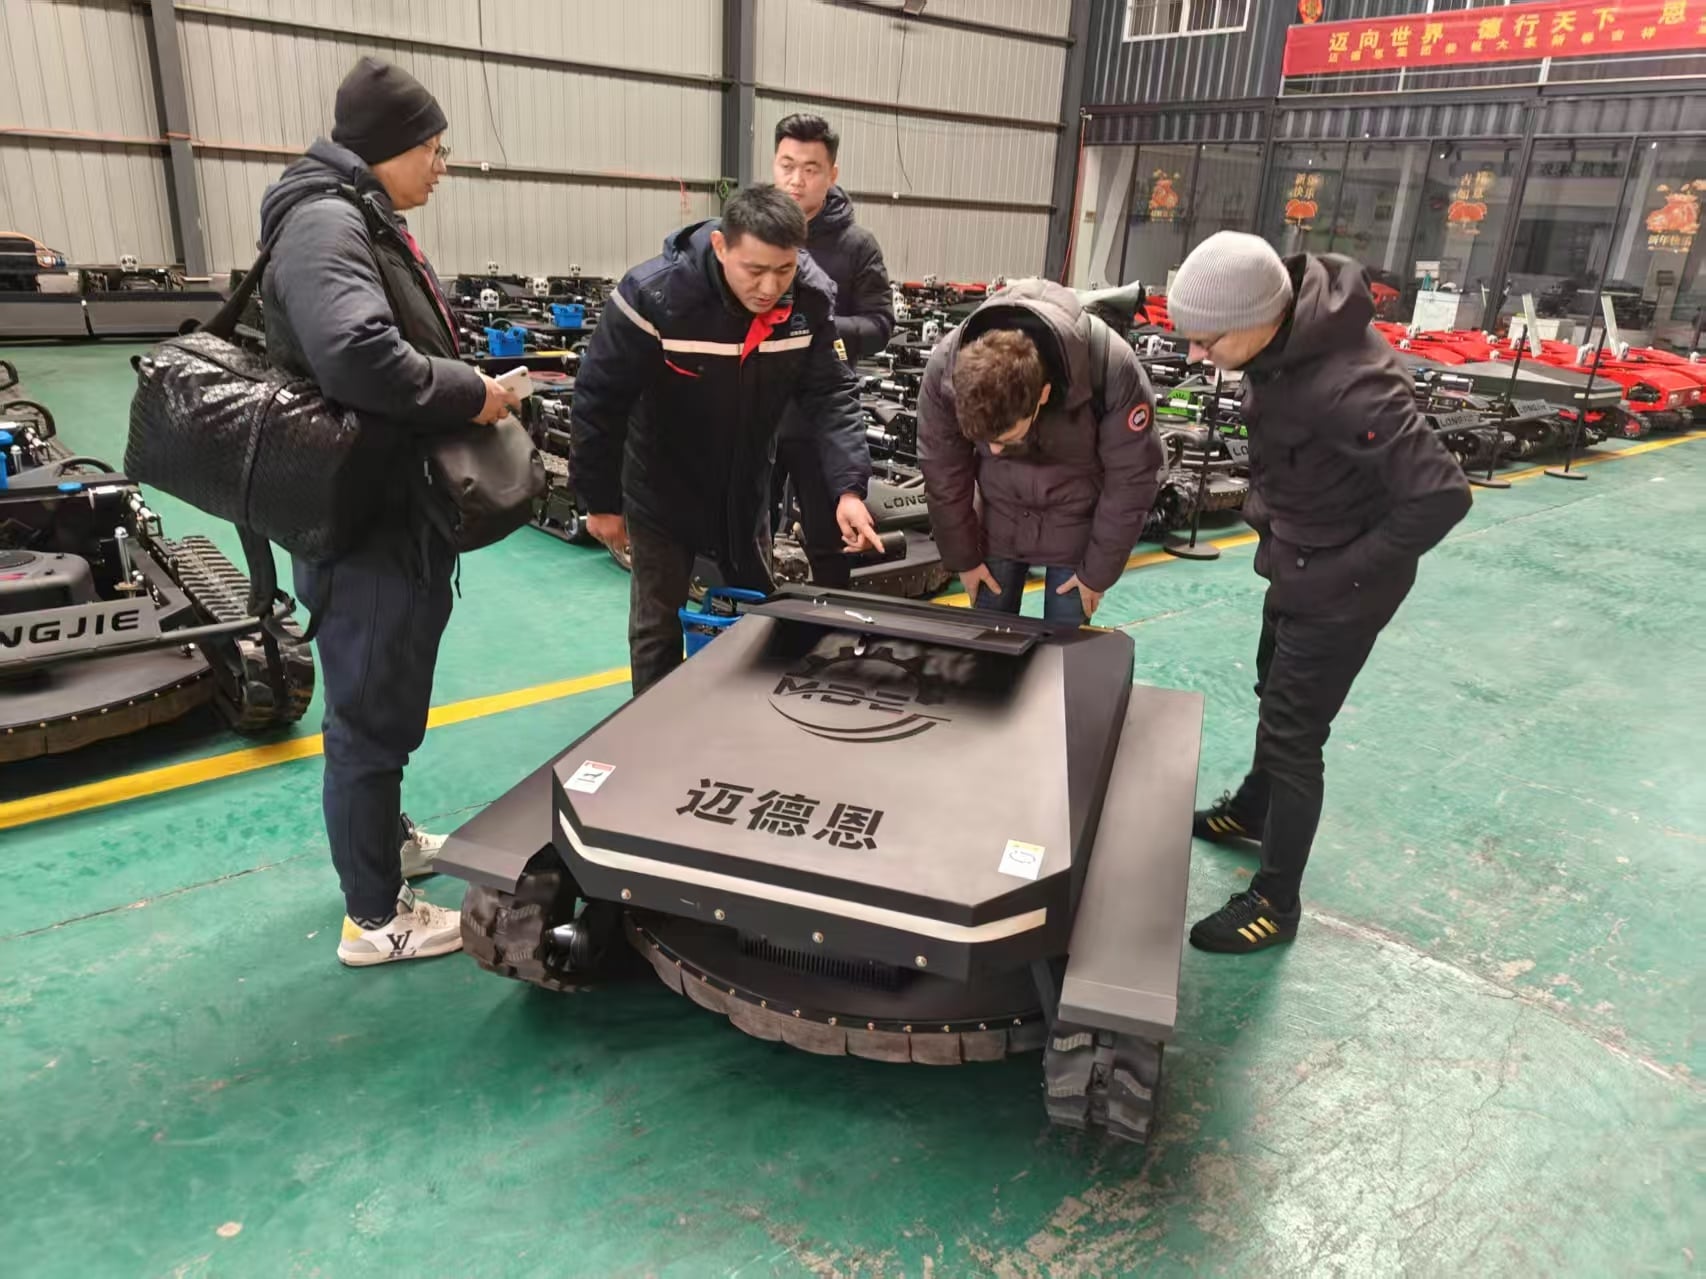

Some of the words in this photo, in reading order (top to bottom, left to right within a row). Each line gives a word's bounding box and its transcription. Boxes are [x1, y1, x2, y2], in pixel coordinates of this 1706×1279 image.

[1328, 23, 1444, 52] 迈向世界
[1478, 8, 1616, 39] 德行天下
[883, 494, 927, 509] LONG
[0, 610, 139, 648] NGJIE
[676, 778, 885, 851] 迈德恩
